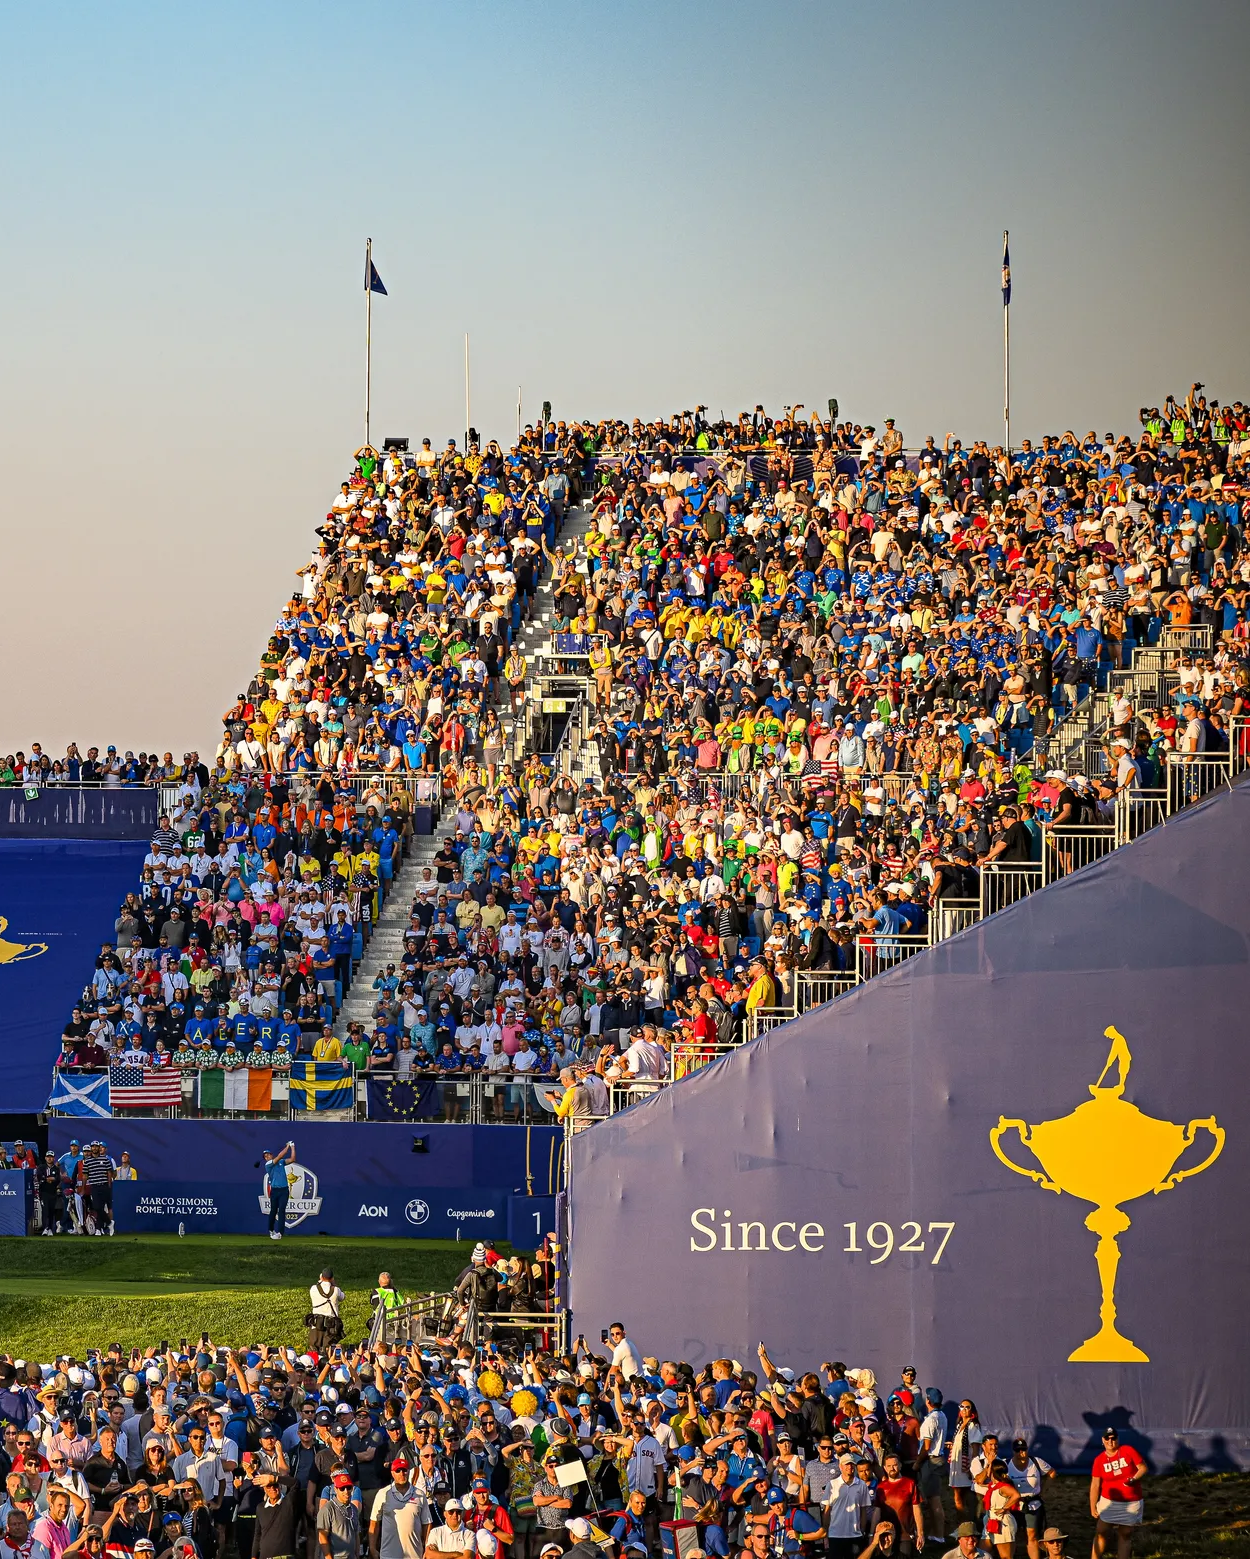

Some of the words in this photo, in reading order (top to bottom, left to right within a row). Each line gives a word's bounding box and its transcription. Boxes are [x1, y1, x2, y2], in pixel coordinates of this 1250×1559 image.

[187, 835, 201, 848] 62
[362, 904, 371, 922] USA
[127, 1055, 144, 1065] USA
[140, 1196, 175, 1206] MARCO
[176, 1197, 214, 1207] SIMONE
[264, 1201, 296, 1210] RER
[297, 1202, 317, 1211] CUP
[135, 1205, 165, 1215] ROME,
[166, 1206, 194, 1214] ITALY
[195, 1207, 218, 1215] 2023
[358, 1204, 388, 1217] AON
[446, 1208, 486, 1221] Capgemini
[532, 1211, 541, 1235] 1
[690, 1208, 825, 1252] Since
[843, 1221, 956, 1265] 1927
[641, 1449, 655, 1458] SOX
[1103, 1457, 1129, 1473] USA
